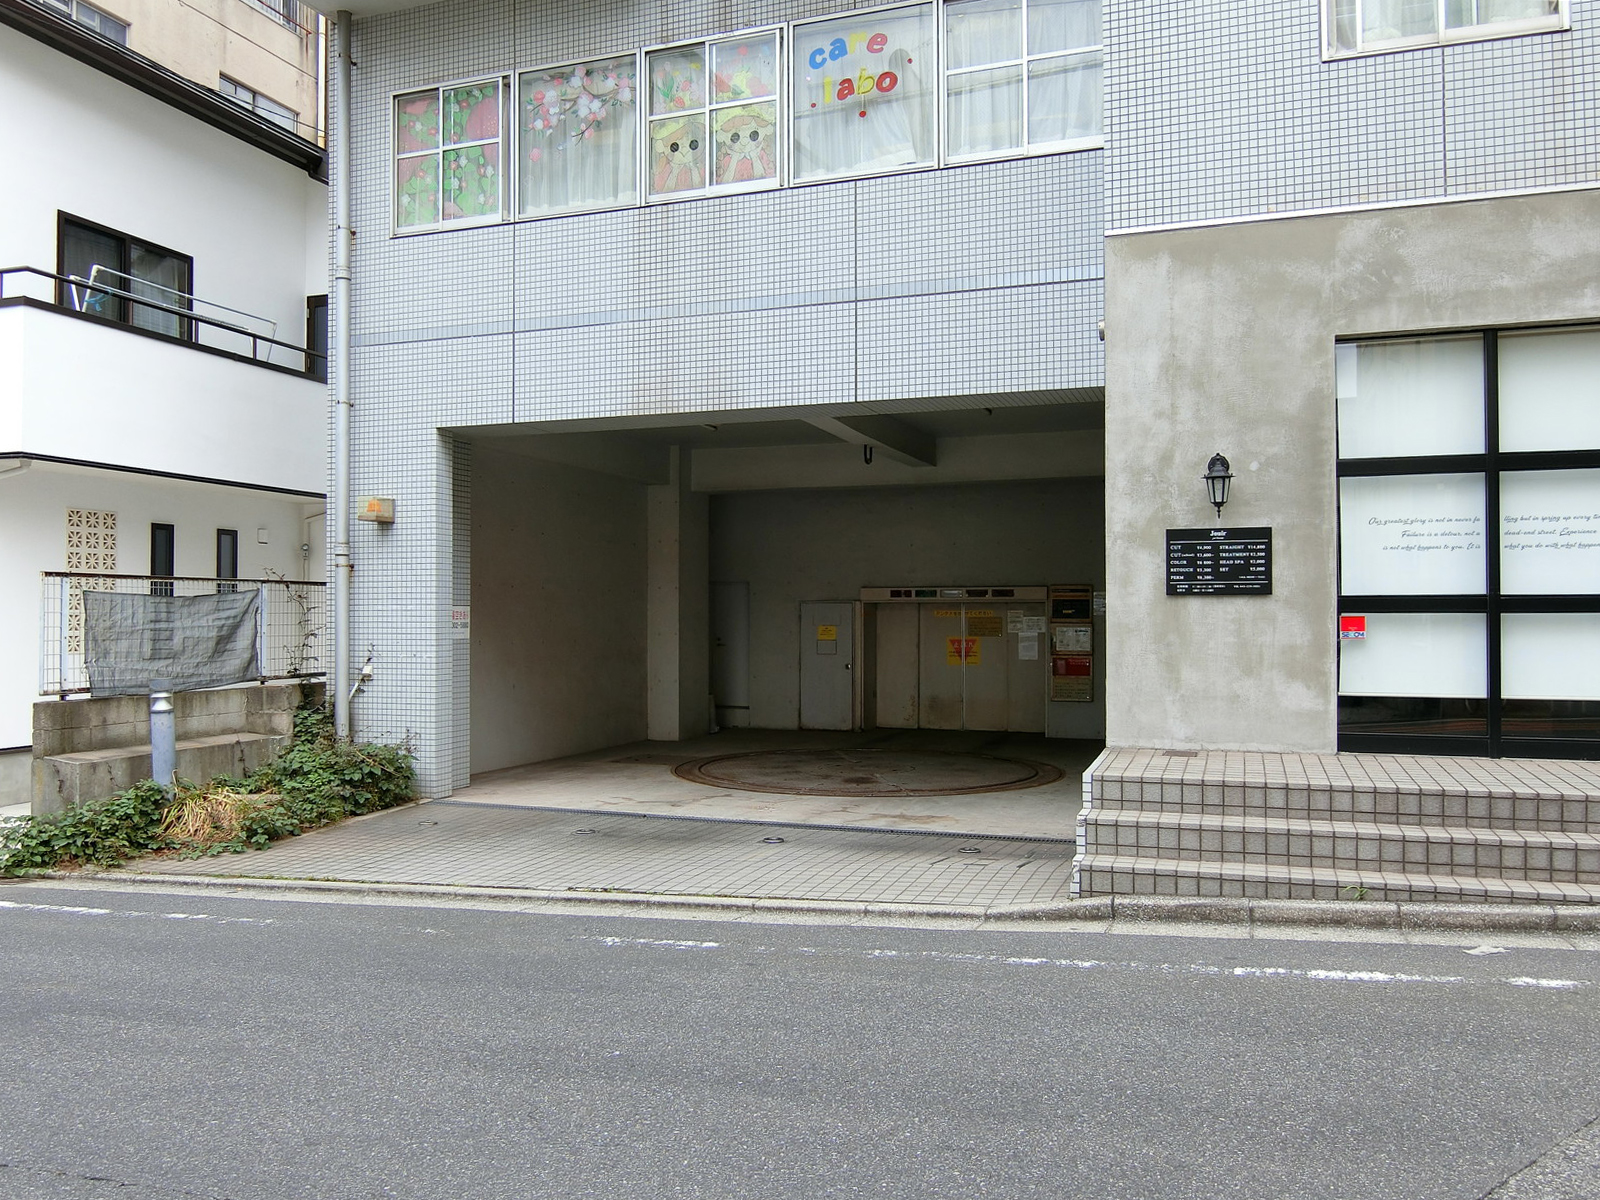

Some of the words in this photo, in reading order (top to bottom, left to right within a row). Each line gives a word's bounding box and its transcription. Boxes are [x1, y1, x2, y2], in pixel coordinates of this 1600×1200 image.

[808, 31, 888, 70] care
[823, 67, 898, 104] labo
[1369, 517, 1382, 525] Our
[1401, 530, 1425, 538] Failure
[1559, 527, 1597, 536] Experience
[1504, 542, 1520, 550] what
[1560, 541, 1577, 549] what
